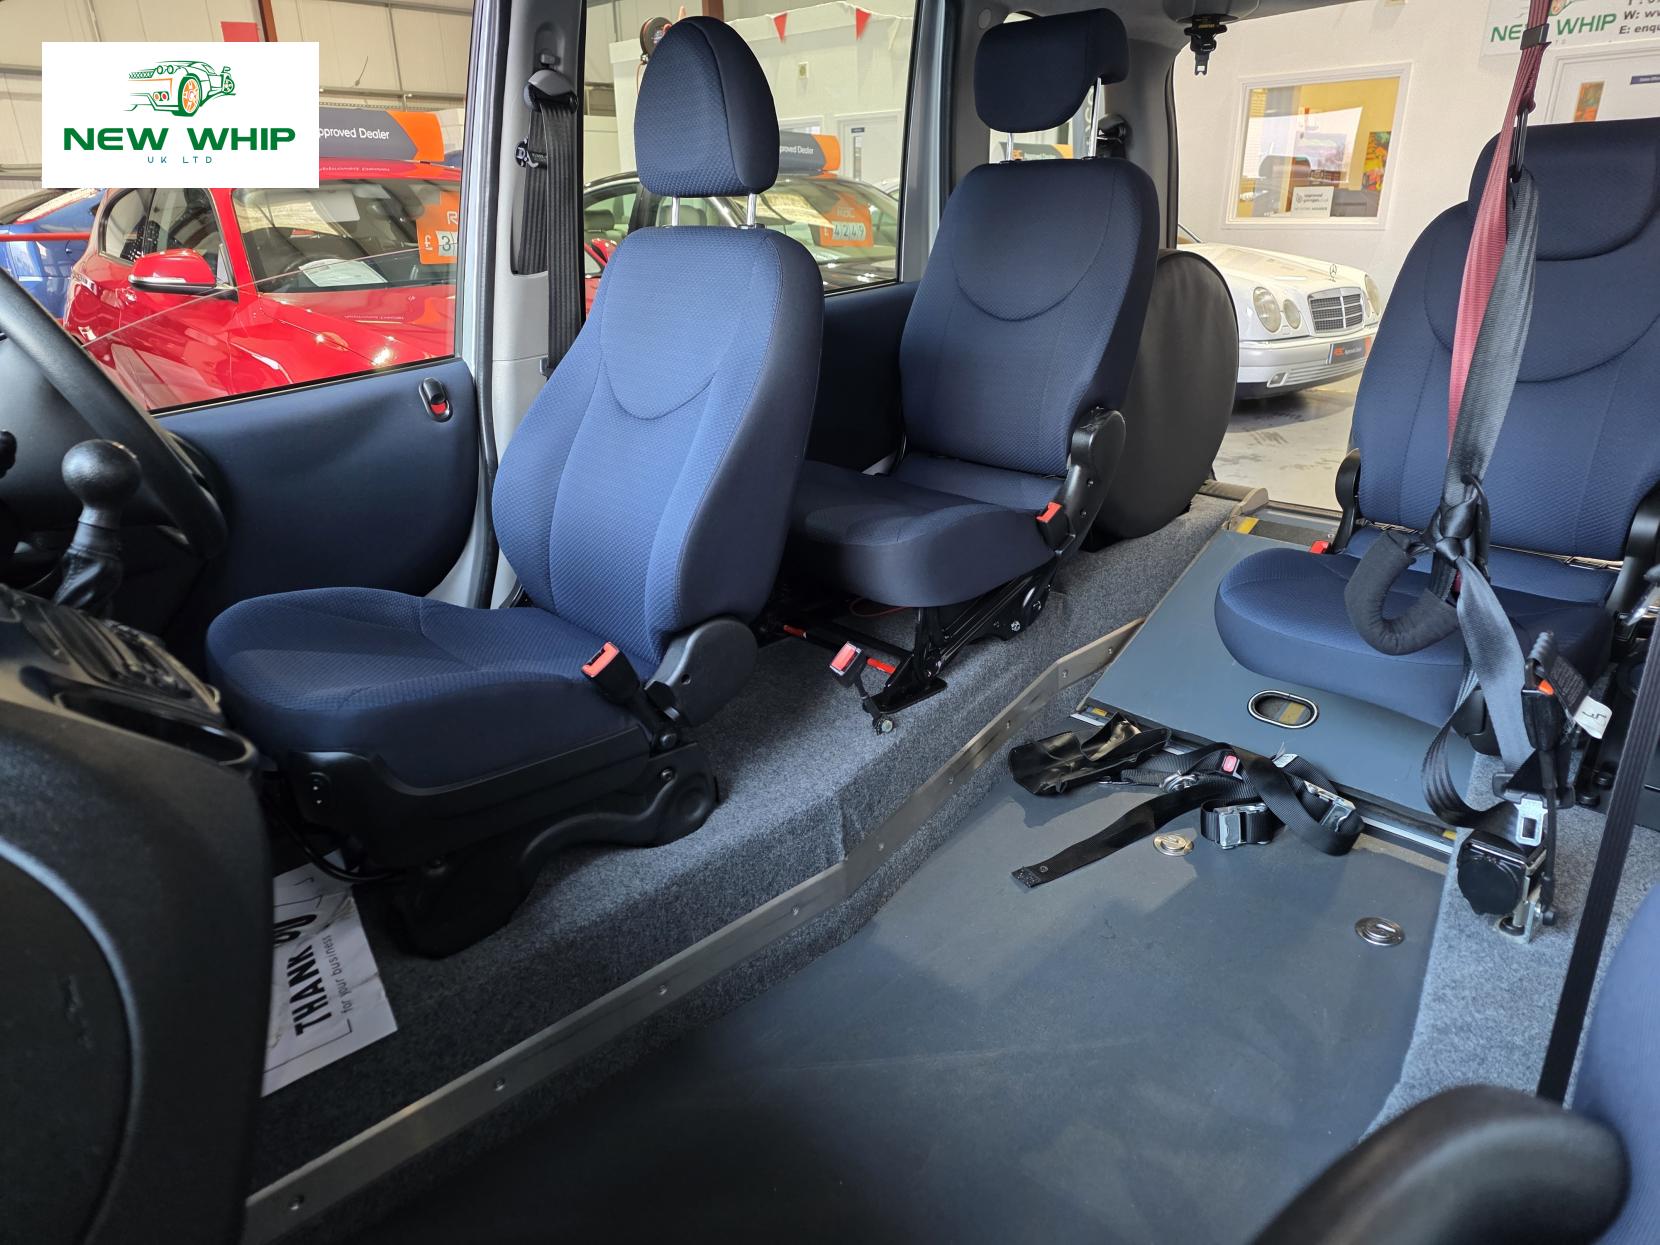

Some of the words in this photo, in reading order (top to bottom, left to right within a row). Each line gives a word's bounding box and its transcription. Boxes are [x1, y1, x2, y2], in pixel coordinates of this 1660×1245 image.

[1624, 10, 1640, 20] W:
[1490, 23, 1528, 43] NE
[1557, 13, 1617, 36] WHIP
[1619, 25, 1631, 35] E:
[359, 128, 390, 139] Dealer
[322, 935, 343, 976] business
[287, 945, 332, 1036] THANK
[335, 977, 351, 997] your
[341, 999, 353, 1014] for
